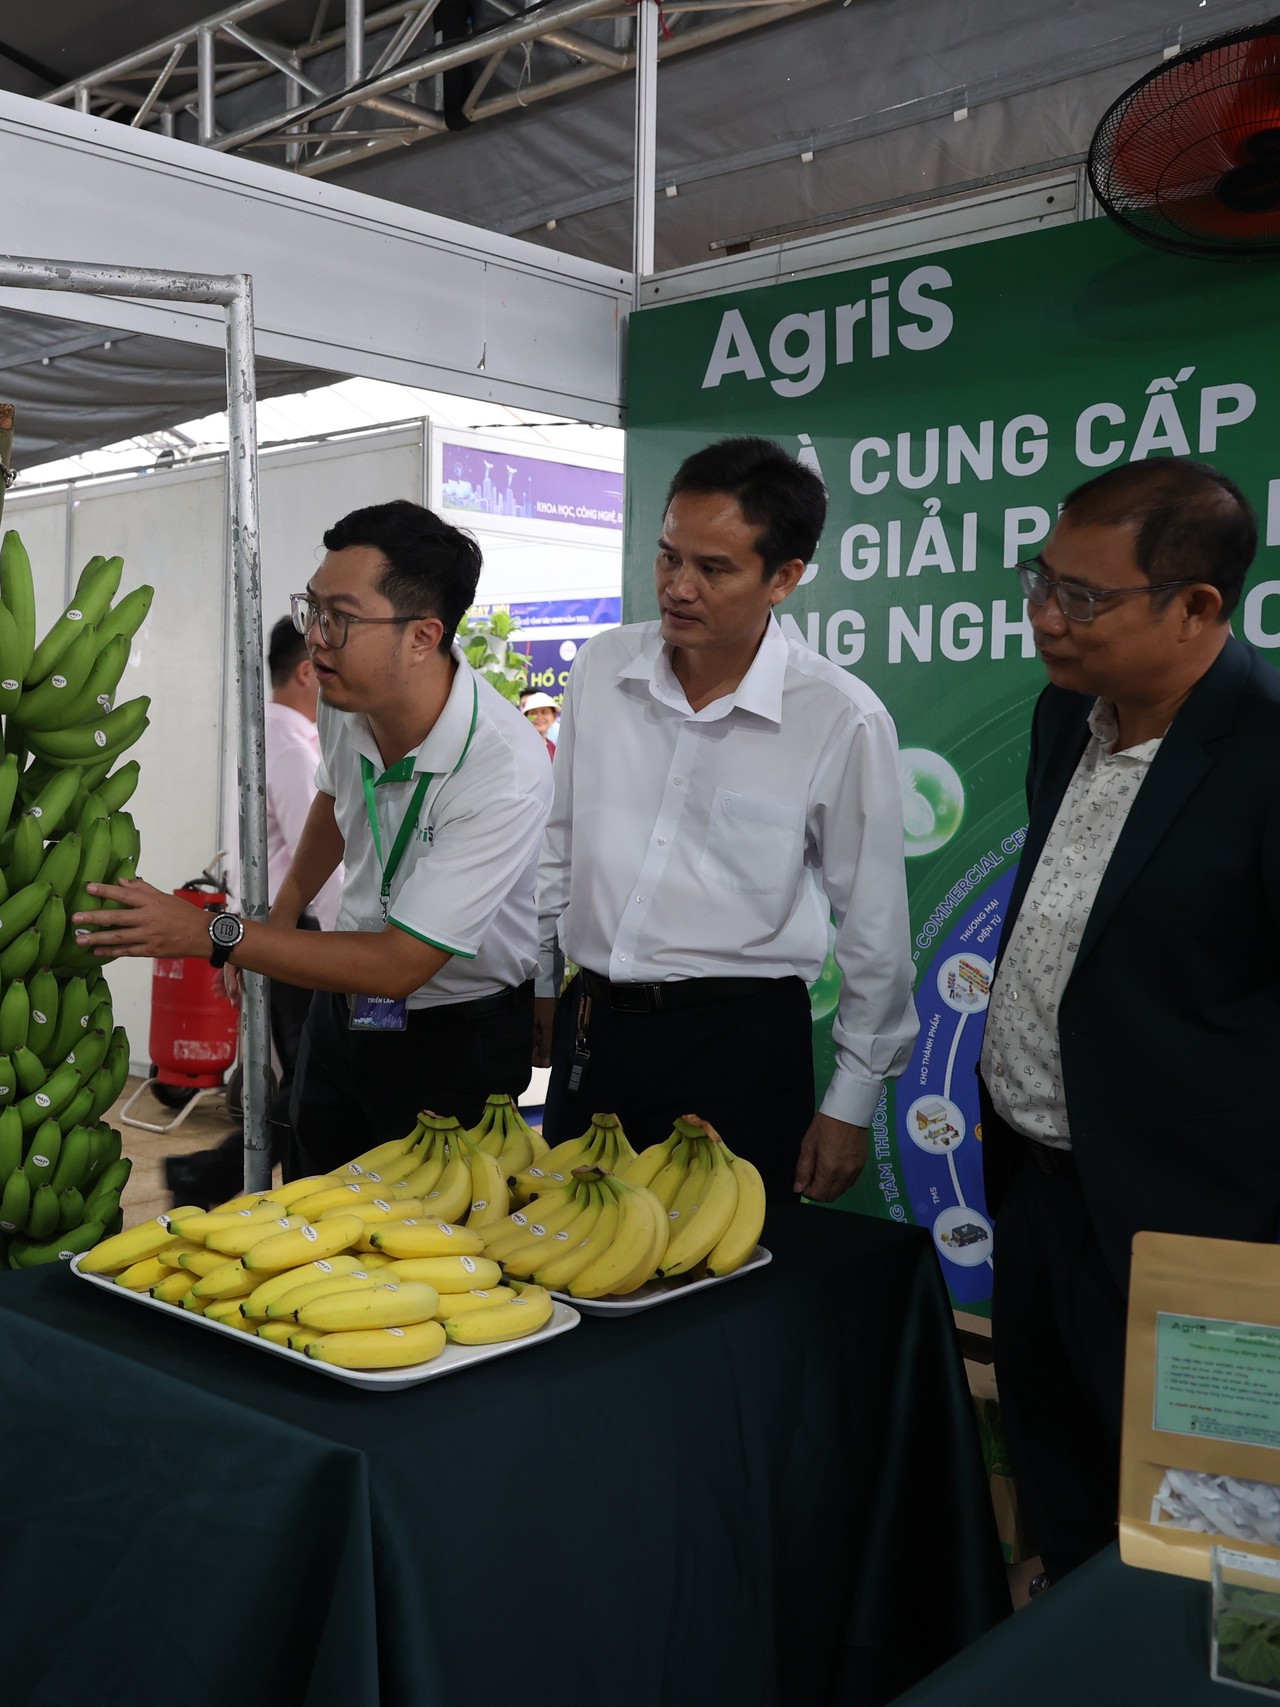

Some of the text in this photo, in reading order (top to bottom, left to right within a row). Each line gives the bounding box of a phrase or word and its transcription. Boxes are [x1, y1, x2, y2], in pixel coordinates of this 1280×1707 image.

[701, 265, 953, 398] AgriS
[850, 414, 1049, 495] CUNG
[1074, 366, 1257, 468] CẤP
[536, 502, 558, 514] KHOA
[840, 497, 978, 581] GIẢI
[888, 598, 1037, 664] NGH
[916, 851, 1004, 949] COMMERCIAL
[920, 1066, 928, 1086] KHO
[922, 1038, 934, 1066] THÀNH
[878, 1163, 900, 1202] TÂM
[930, 1186, 940, 1204] TMS
